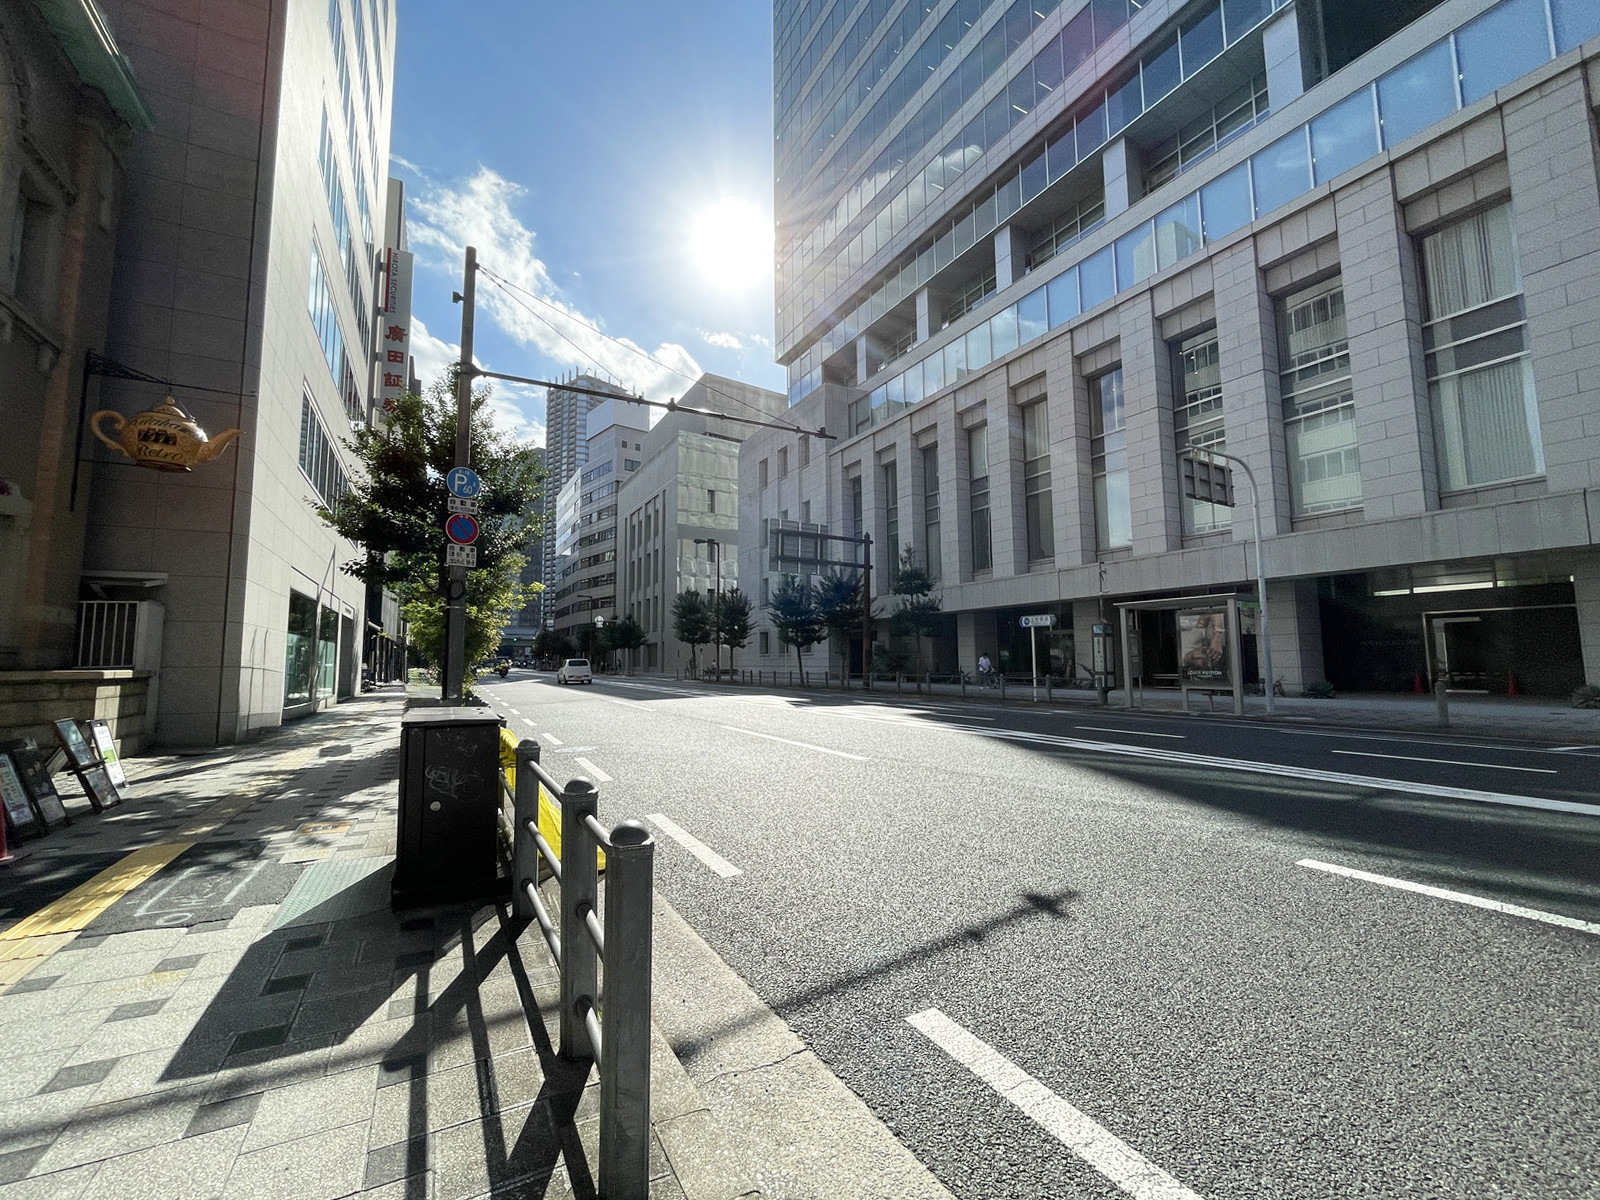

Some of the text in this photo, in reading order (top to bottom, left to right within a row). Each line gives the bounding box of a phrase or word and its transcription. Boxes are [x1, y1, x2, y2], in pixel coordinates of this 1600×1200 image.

[389, 252, 399, 314] HIROTA SECURITIES
[137, 444, 183, 461] Retro
[454, 473, 467, 491] P
[462, 484, 473, 494] 60
